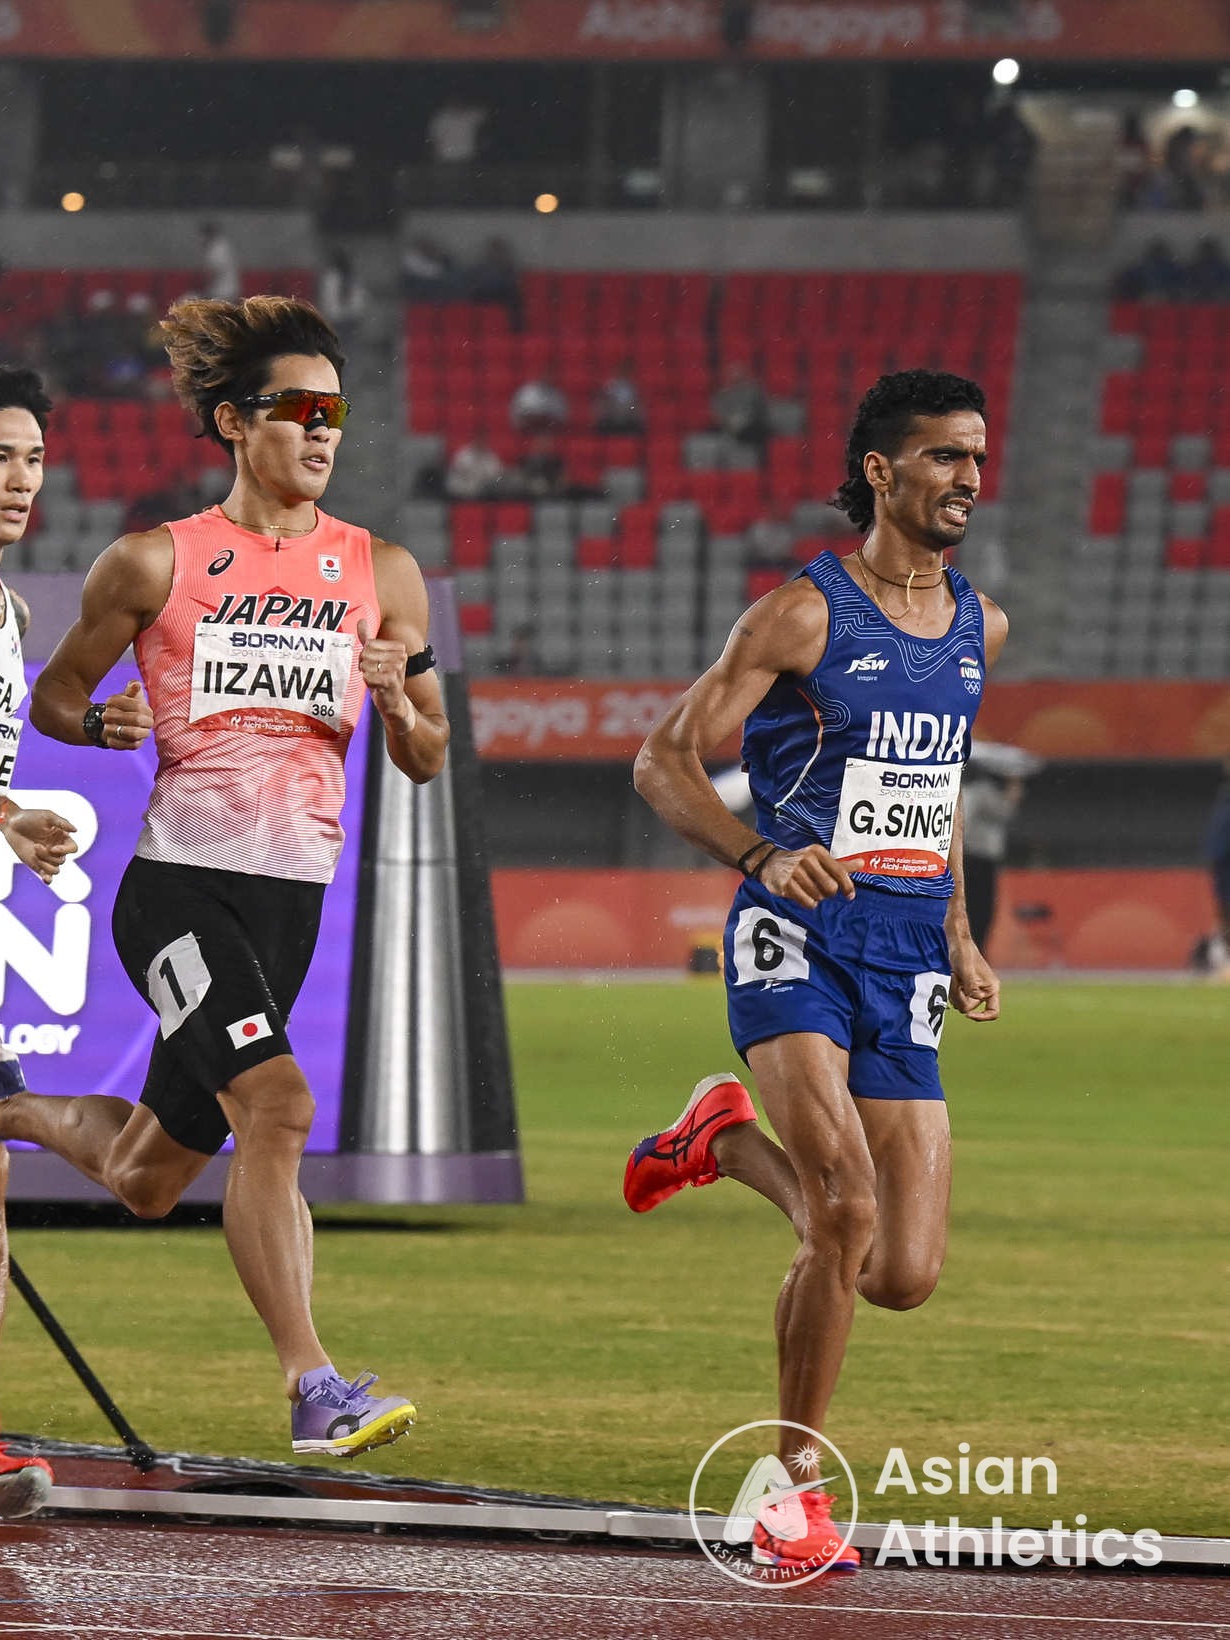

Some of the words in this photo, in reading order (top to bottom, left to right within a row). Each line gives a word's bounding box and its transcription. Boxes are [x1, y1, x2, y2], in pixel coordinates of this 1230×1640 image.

[201, 593, 349, 633] JAPAN
[229, 632, 325, 652] BORNAN
[203, 661, 335, 702] IIZAWA
[843, 659, 890, 674] JSW
[960, 666, 981, 680] INDIA
[312, 704, 335, 717] 386
[866, 711, 967, 761] INDIA
[879, 771, 951, 789] BORNAN
[849, 799, 953, 839] G.SINGH
[752, 917, 785, 972] 6
[159, 956, 188, 1012] 1
